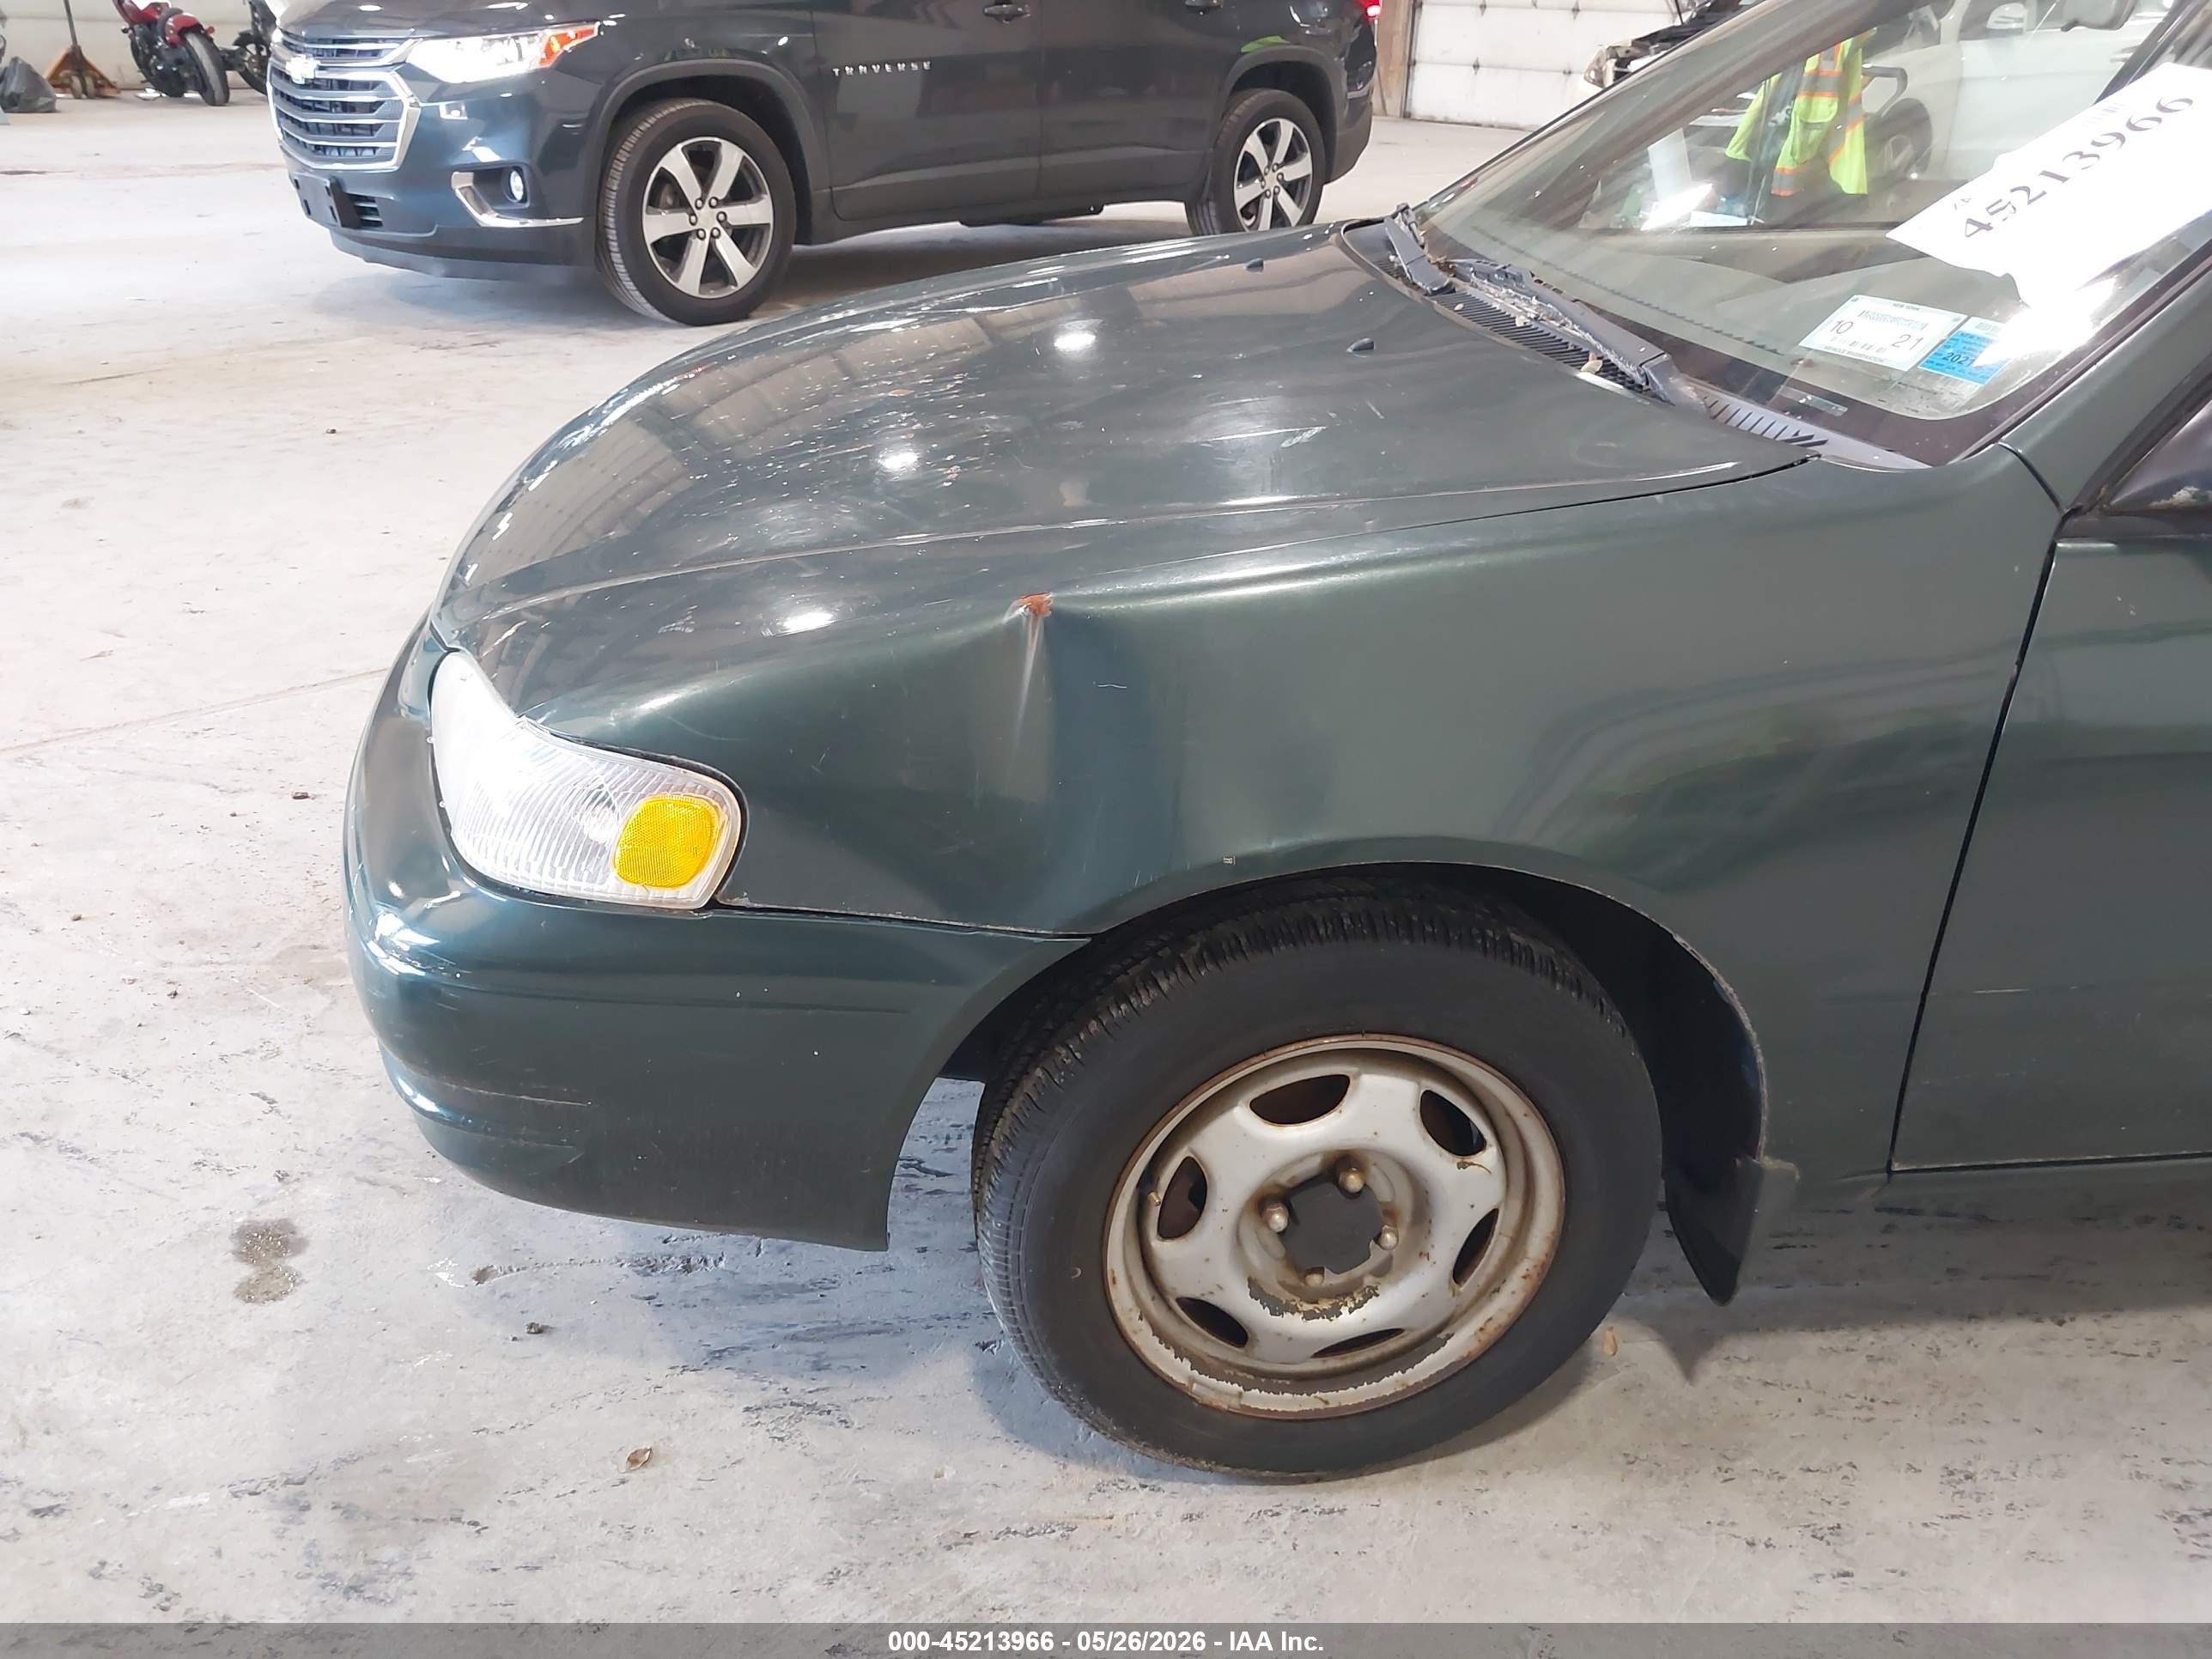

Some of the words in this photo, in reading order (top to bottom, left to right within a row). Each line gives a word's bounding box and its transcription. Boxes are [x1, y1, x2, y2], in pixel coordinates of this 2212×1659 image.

[832, 60, 932, 77] TRAVERSE
[1963, 95, 2195, 239] 45213966
[1829, 319, 1854, 335] 10
[1891, 332, 1924, 351] 21
[1942, 352, 1977, 367] 2021
